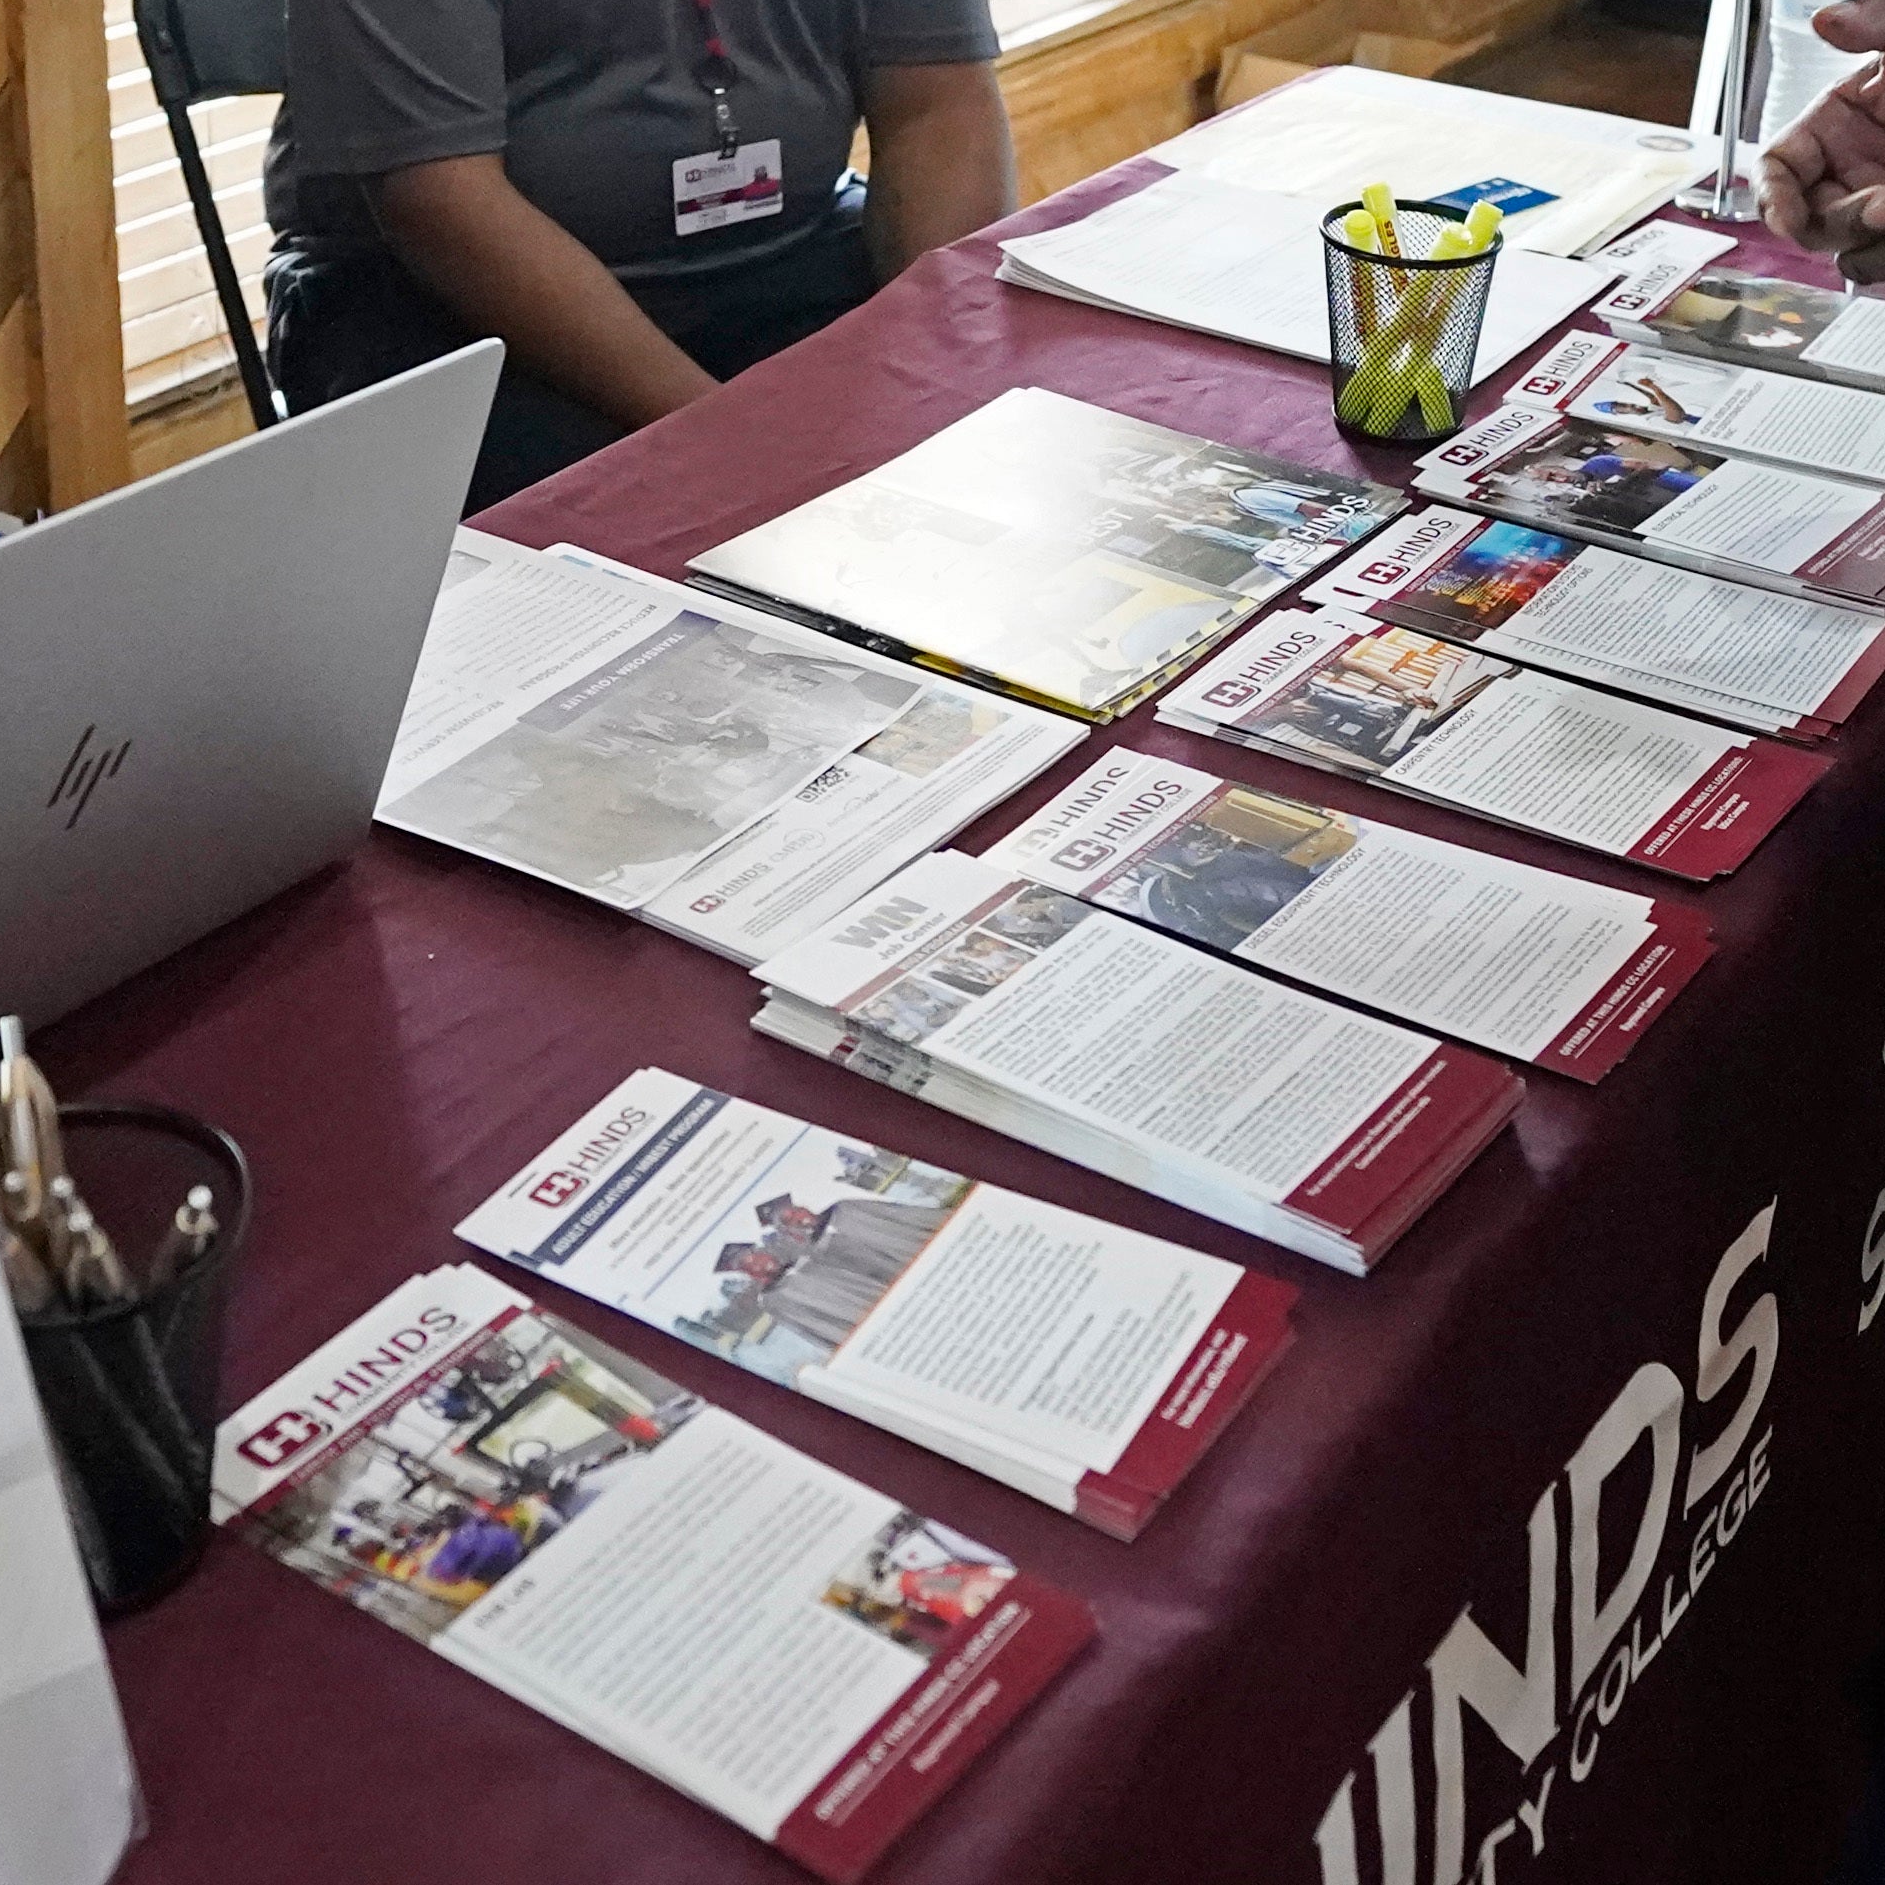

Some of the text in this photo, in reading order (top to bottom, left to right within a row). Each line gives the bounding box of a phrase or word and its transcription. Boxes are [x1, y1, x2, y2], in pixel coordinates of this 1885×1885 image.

[1542, 340, 1593, 377] HINDS
[1469, 411, 1534, 448] HINDS
[1290, 493, 1370, 543] HINDS
[1387, 516, 1452, 564] HINDS
[558, 629, 685, 713] TRANSFORM YOUR LIFE
[1236, 629, 1319, 682] HINDS
[1393, 708, 1479, 776] CARPENTRY TECHNOLOGY
[1092, 777, 1185, 841] HINDS
[718, 862, 769, 898] HINDS
[1313, 845, 1367, 893] TECHNOLOGY
[828, 893, 932, 950] WIN
[873, 911, 951, 961] Job Center
[1556, 1025, 1592, 1057] OFFERED
[565, 1104, 649, 1173] HINDS
[545, 1221, 589, 1256] ADULT
[312, 1306, 458, 1413] HINDS
[1570, 1425, 1776, 1784] COLLEGE
